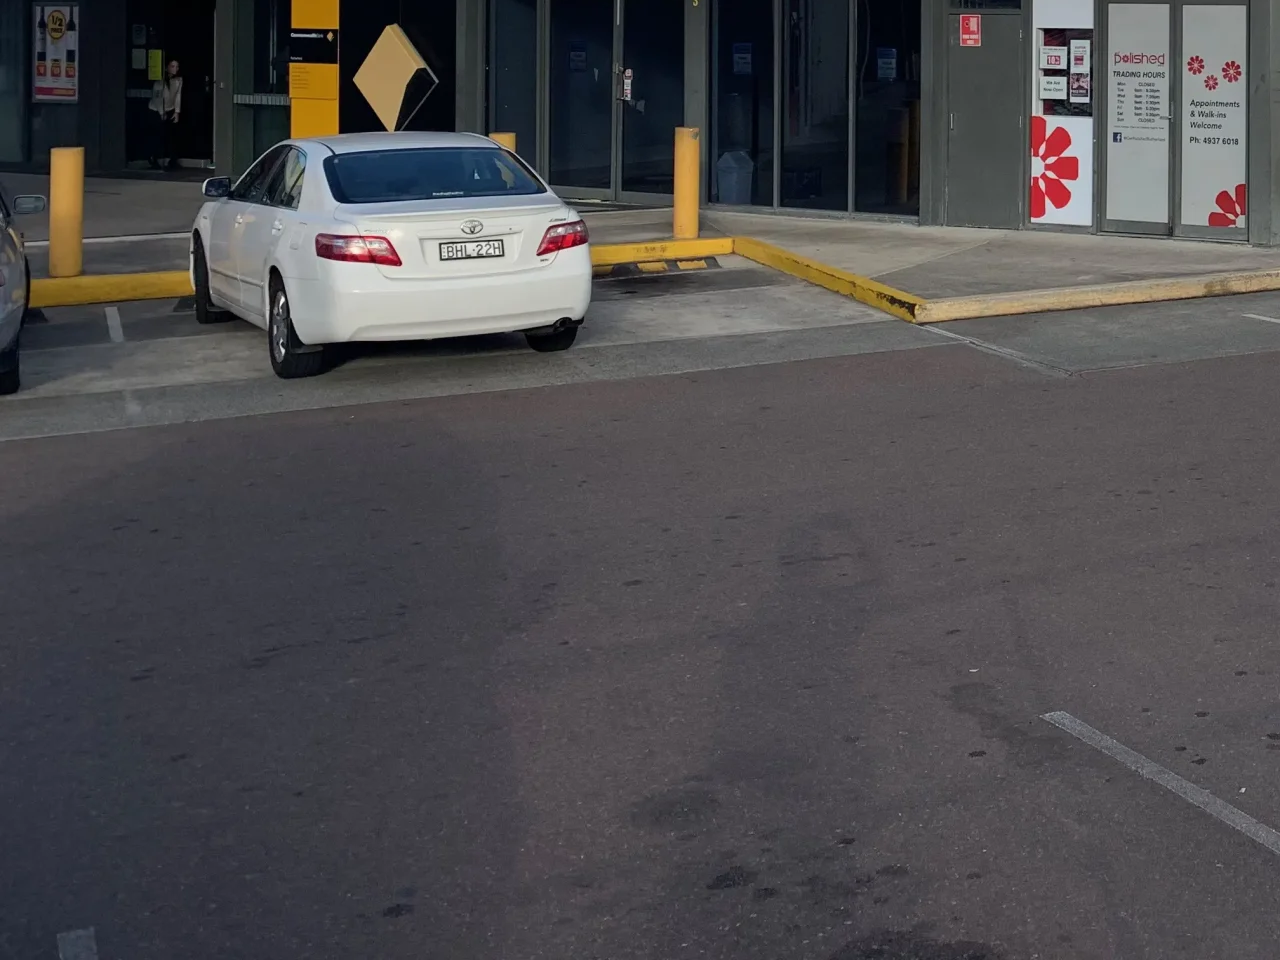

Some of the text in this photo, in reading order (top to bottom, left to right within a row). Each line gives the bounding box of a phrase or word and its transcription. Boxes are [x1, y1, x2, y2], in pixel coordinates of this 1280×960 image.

[1112, 70, 1166, 79] TRADING HOURS
[1190, 99, 1240, 108] Appointments
[1198, 110, 1227, 118] Walk-ins
[1190, 121, 1223, 130] Welcome
[1190, 136, 1201, 144] Ph:
[1203, 137, 1220, 145] 4937
